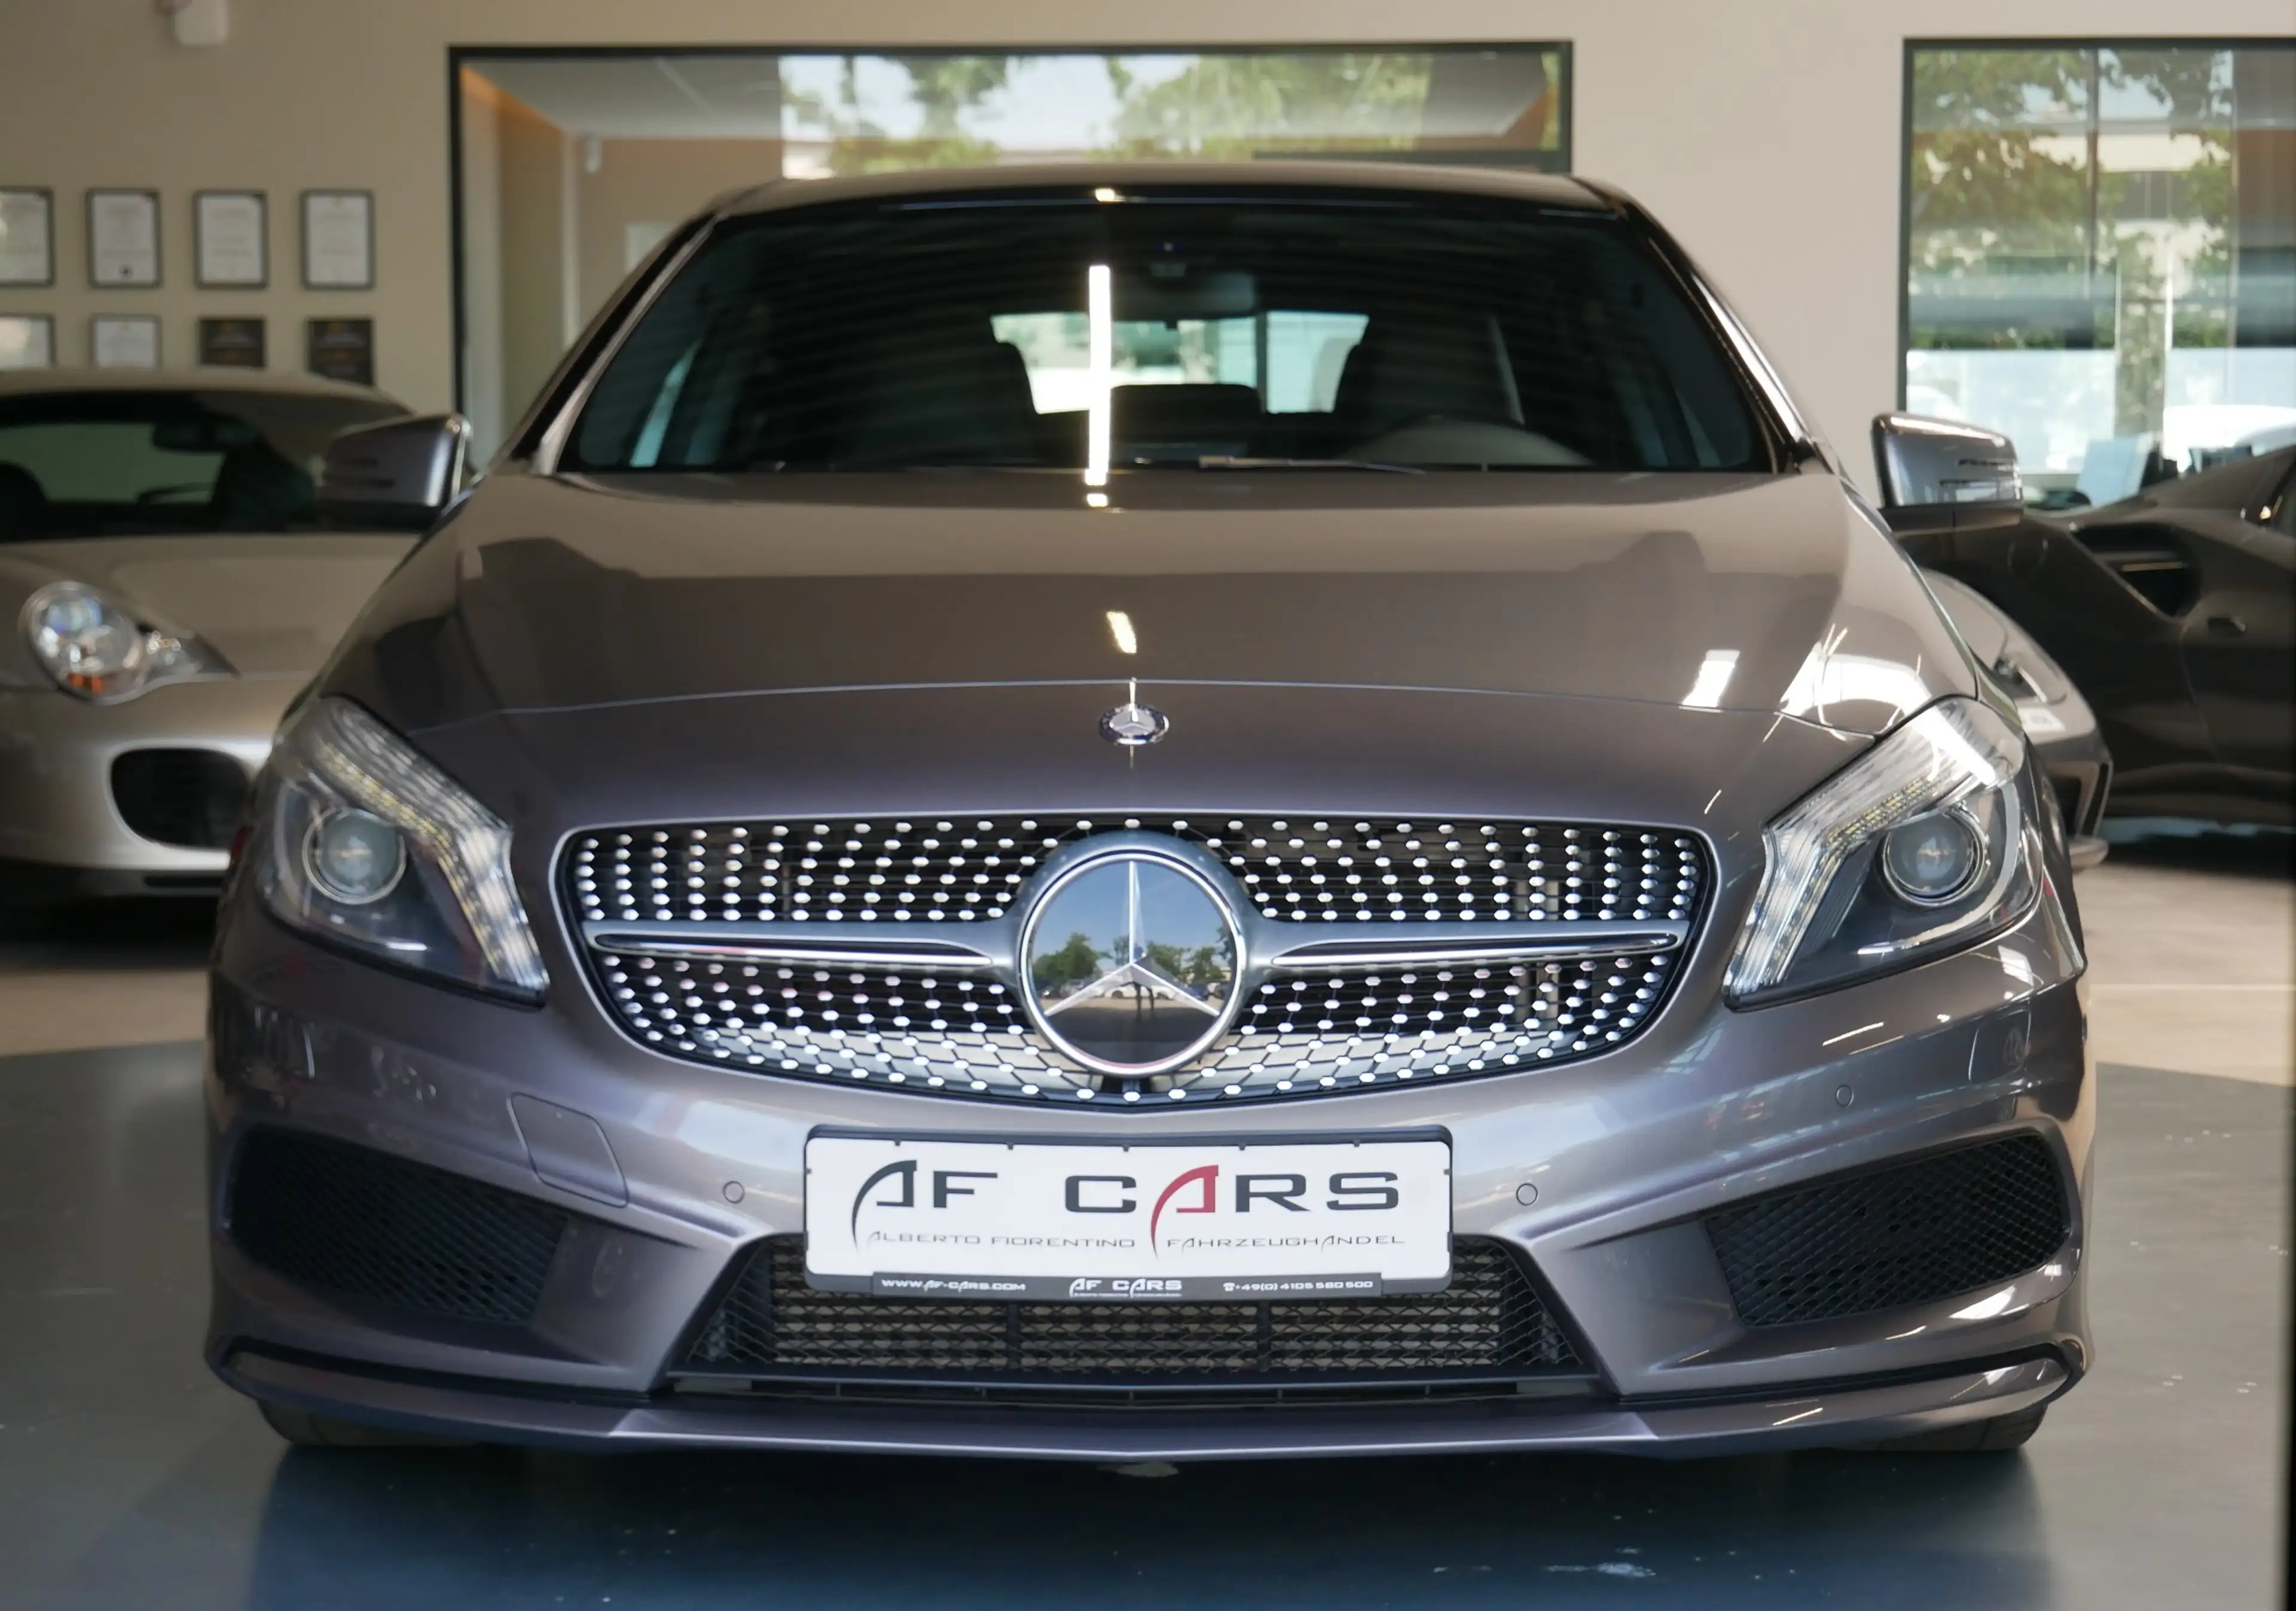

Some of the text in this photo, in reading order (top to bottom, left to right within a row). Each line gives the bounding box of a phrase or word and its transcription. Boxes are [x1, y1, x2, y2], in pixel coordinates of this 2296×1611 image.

[851, 1159, 1399, 1257] AF CARS
[868, 1230, 1405, 1253] ALBERTO FIORENTINO FAHRZEUGHANDEL
[1069, 1277, 1183, 1298] AF CARS
